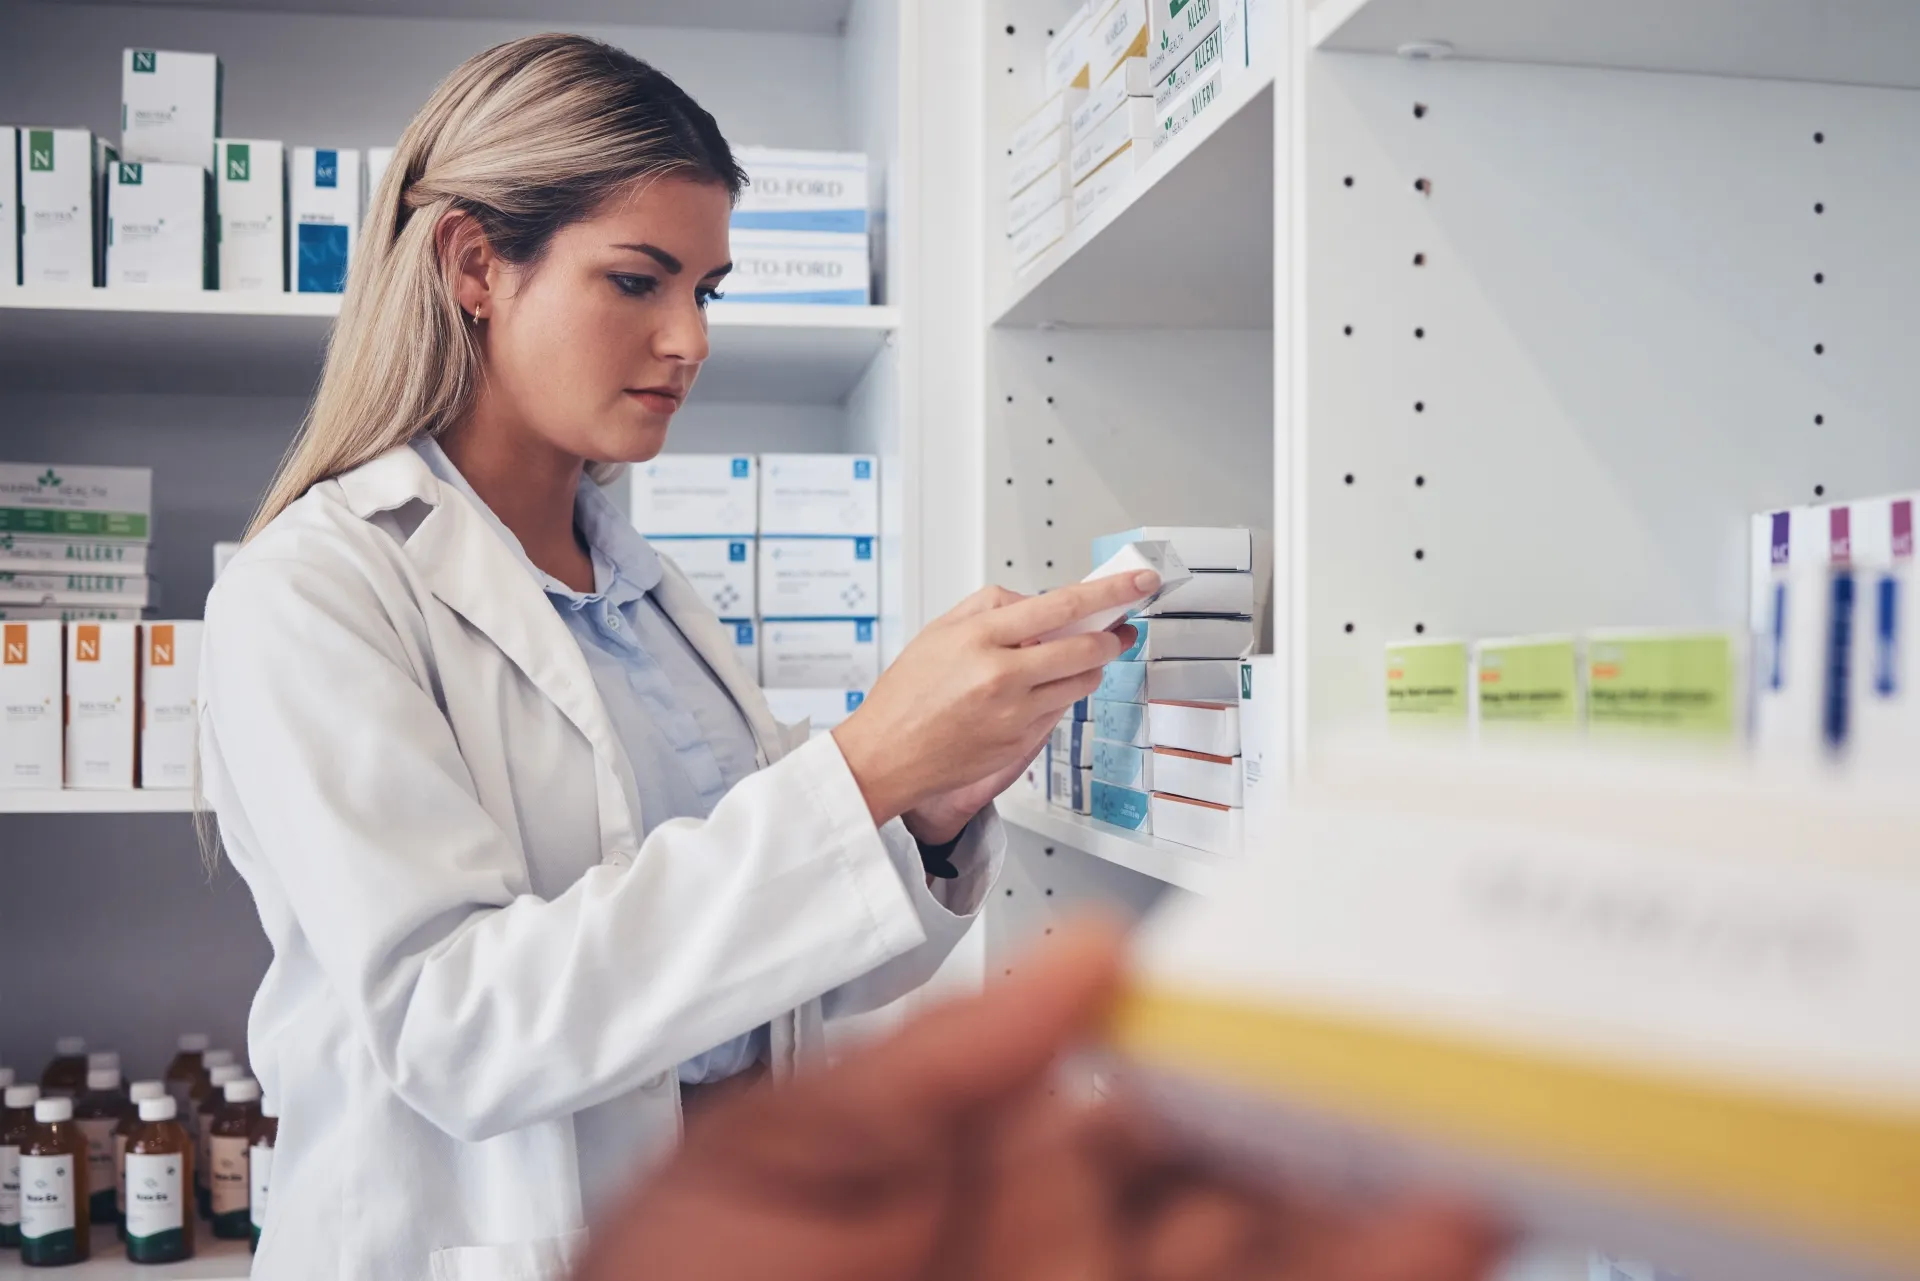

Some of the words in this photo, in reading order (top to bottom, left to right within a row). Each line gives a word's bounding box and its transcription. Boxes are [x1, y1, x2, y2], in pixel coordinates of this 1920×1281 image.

[1168, 31, 1185, 55] HEALTH
[1194, 31, 1219, 73] ALLERY
[137, 53, 152, 69] N
[1174, 68, 1192, 92] HEALTH
[1191, 79, 1214, 118] ALLERY
[33, 150, 50, 168] N
[121, 164, 139, 182] N
[229, 160, 246, 178] N
[66, 544, 124, 560] ALLERY
[67, 574, 125, 591] ALLERY
[7, 642, 25, 661] N
[79, 639, 97, 658] N
[154, 643, 171, 663] N
[1243, 668, 1252, 691] N
